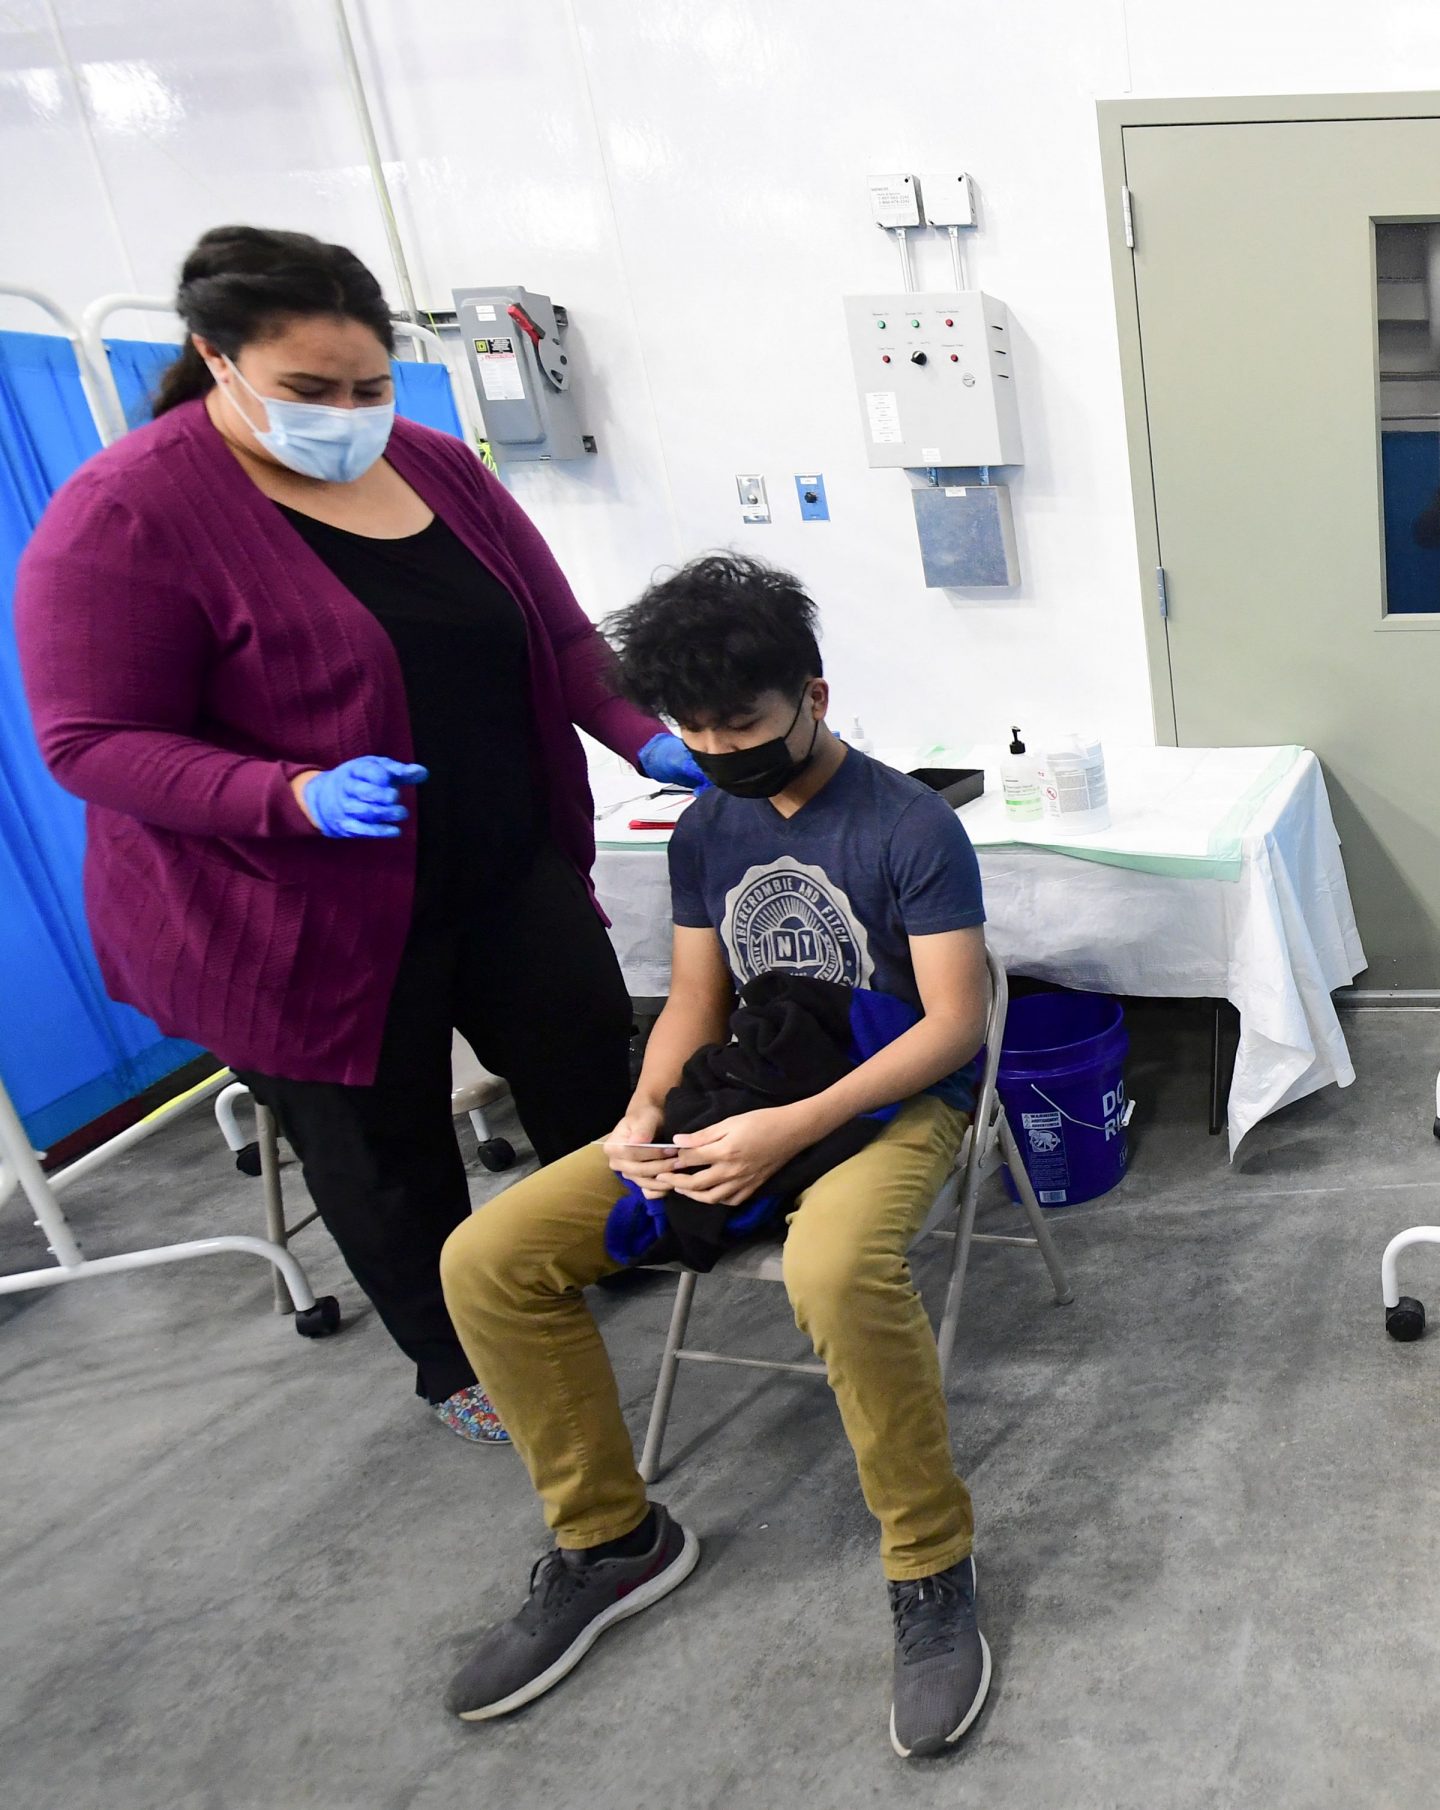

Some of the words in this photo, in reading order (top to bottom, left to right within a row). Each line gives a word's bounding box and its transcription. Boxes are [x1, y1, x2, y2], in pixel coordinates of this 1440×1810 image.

[737, 878, 794, 944] ABERCROMBIE
[798, 882, 820, 903] AND
[820, 906, 850, 943] FITCH
[777, 936, 792, 957] N
[801, 934, 811, 956] Y
[1102, 1080, 1124, 1118] DO
